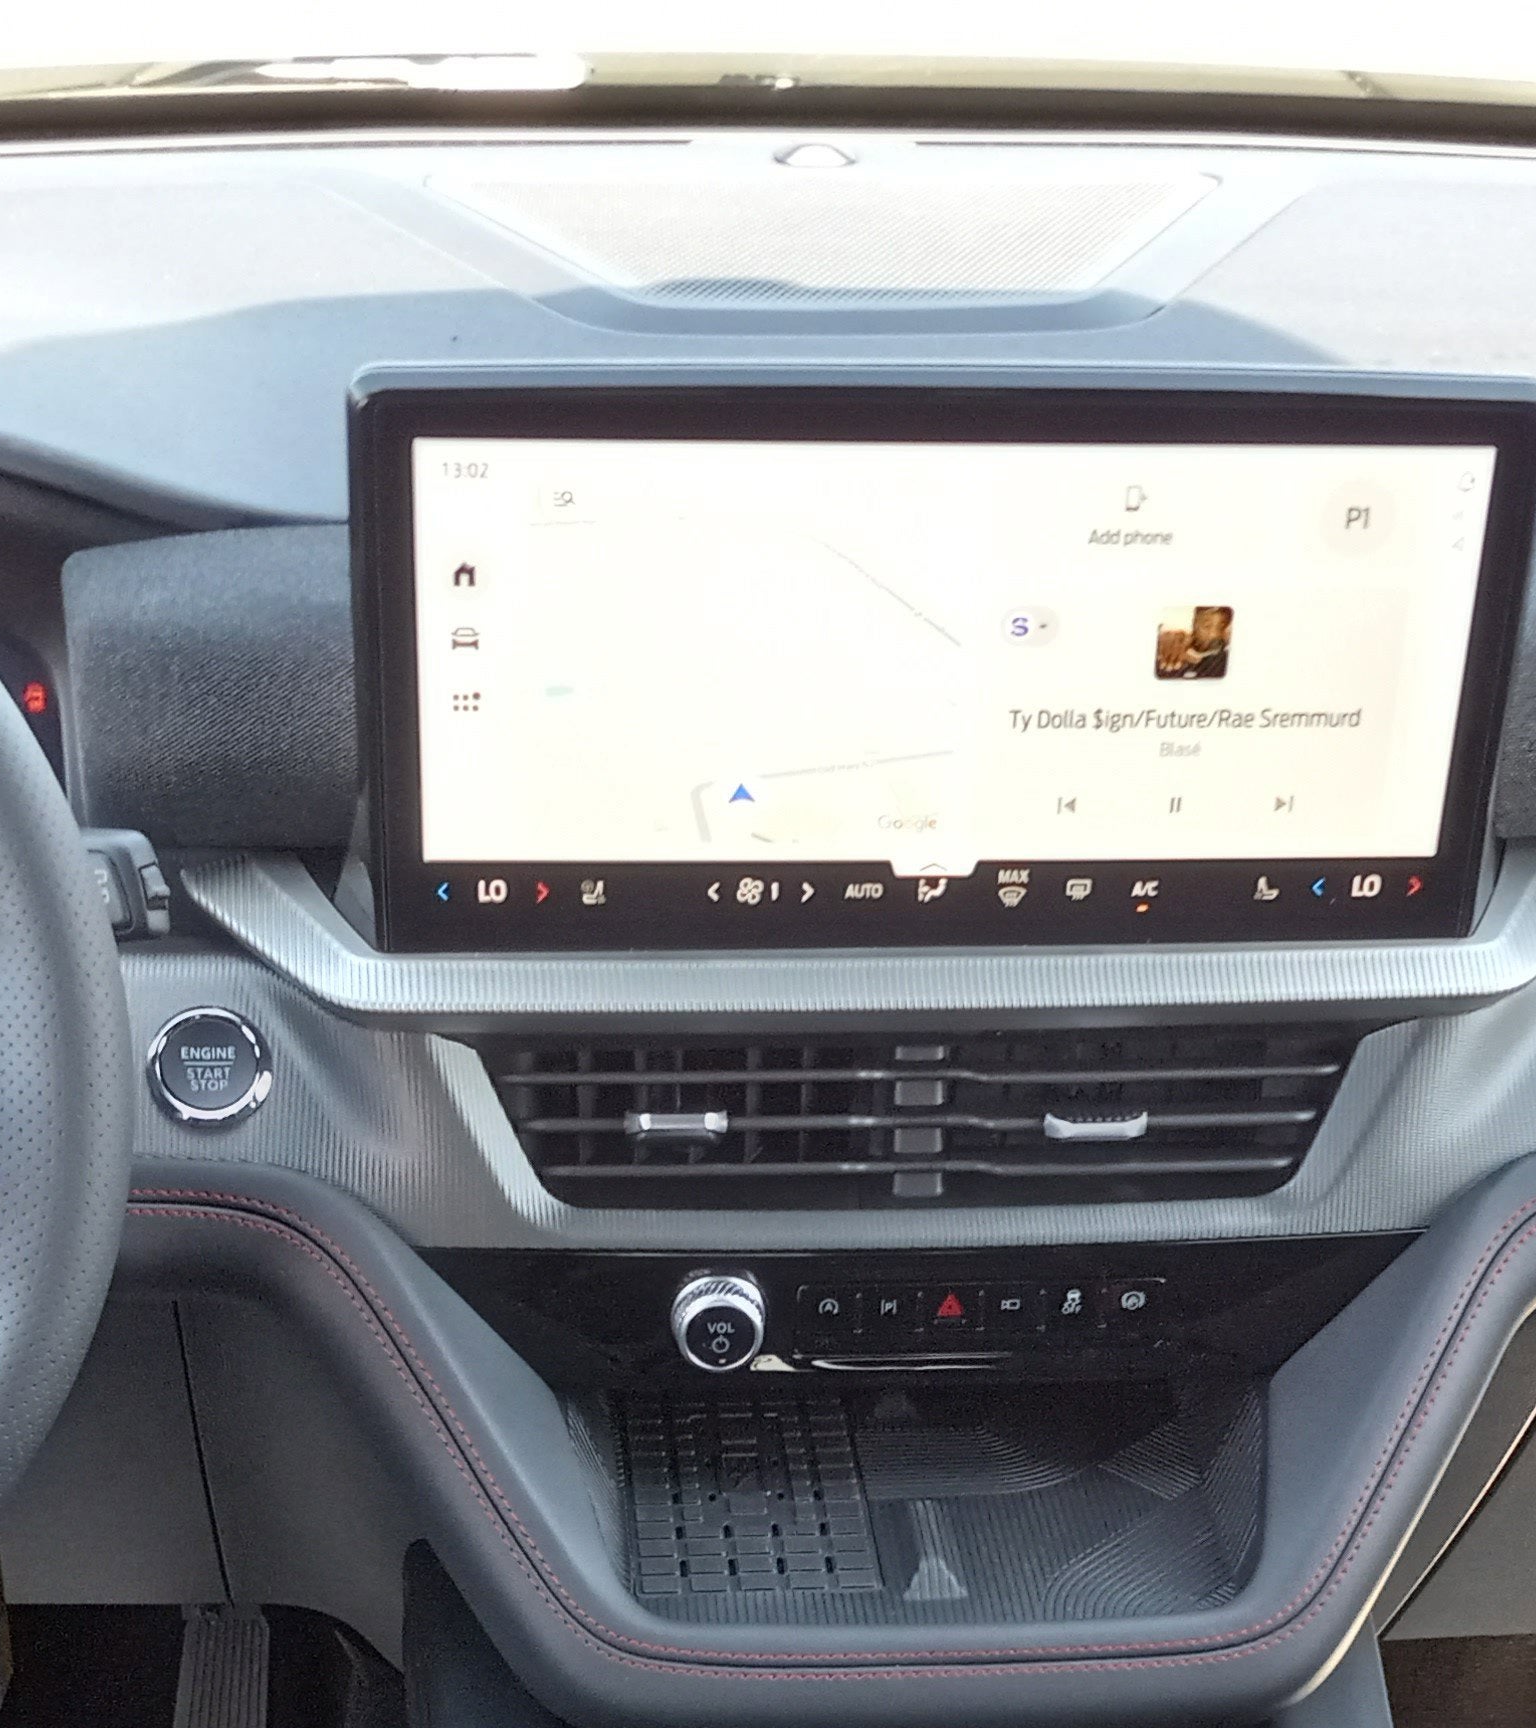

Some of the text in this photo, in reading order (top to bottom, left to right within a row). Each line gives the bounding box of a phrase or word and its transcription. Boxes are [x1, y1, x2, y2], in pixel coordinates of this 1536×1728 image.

[441, 462, 489, 479] 13:02
[1344, 506, 1371, 530] P1
[1088, 529, 1174, 547] Add phone
[1008, 707, 1363, 733] Ty Dolla $ign/Future/Rae Sremmurd
[1159, 741, 1202, 758] Blasé
[877, 813, 938, 833] Google
[997, 868, 1031, 884] MAX
[477, 878, 508, 904] LO
[844, 883, 884, 900] AUTO
[1130, 880, 1160, 898] A/C
[1351, 873, 1383, 898] LO
[180, 1045, 237, 1061] ENGINE
[186, 1066, 231, 1080] START
[190, 1079, 229, 1092] STOP
[706, 1321, 736, 1335] VOL
